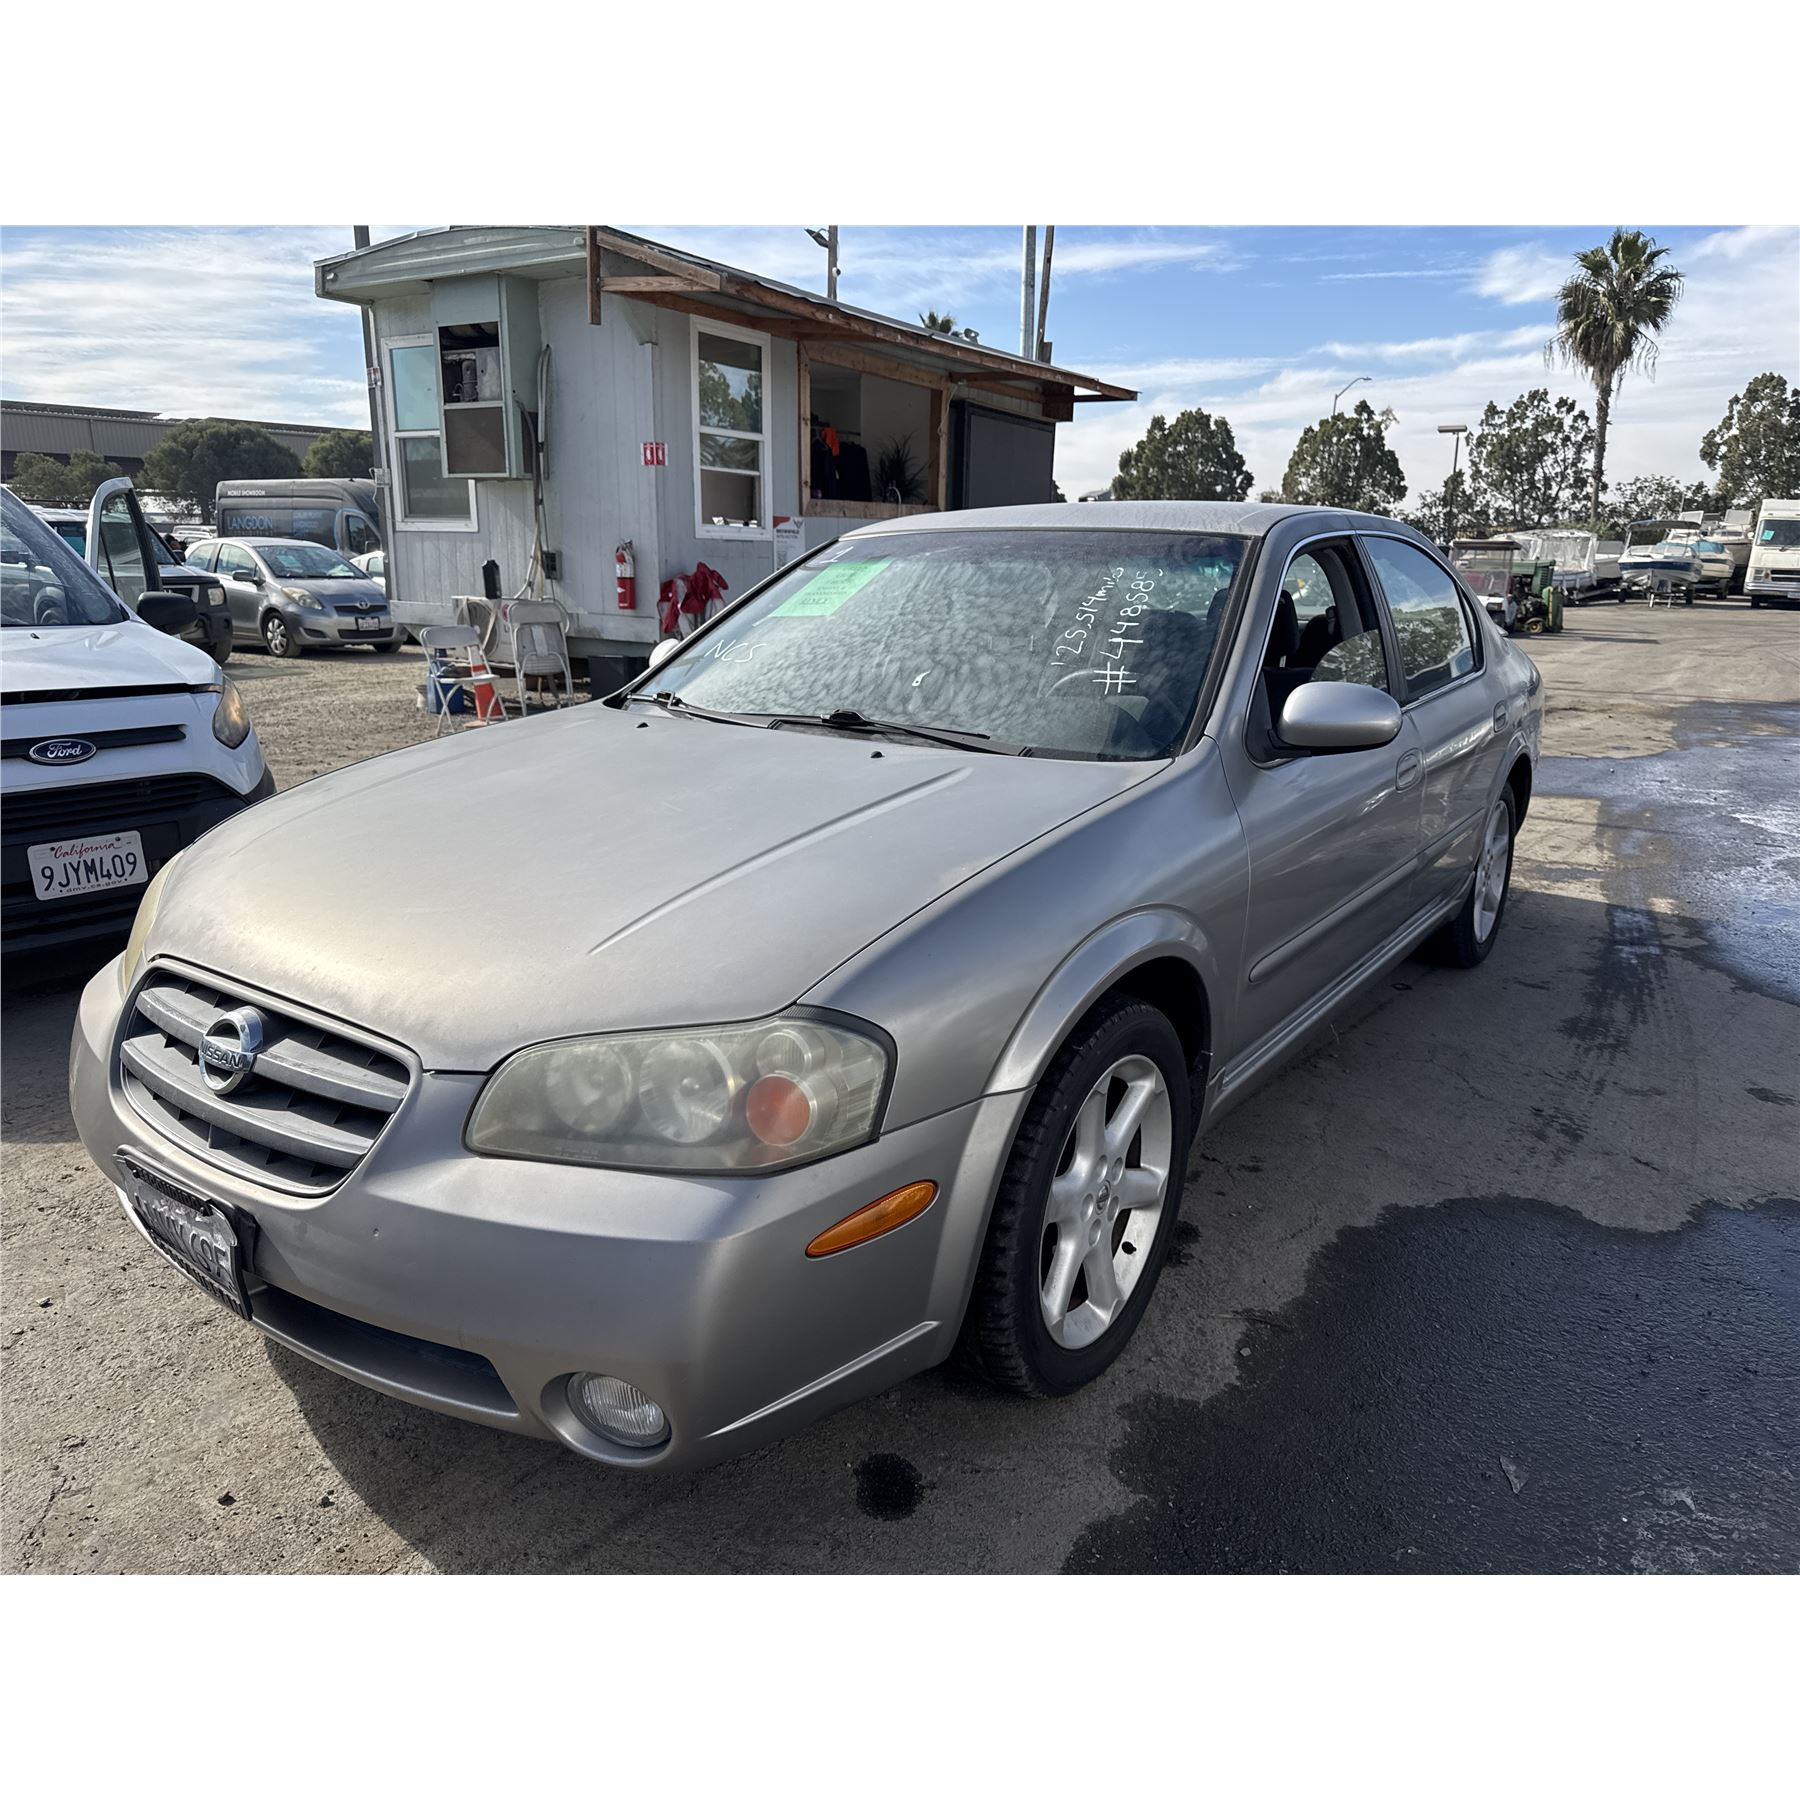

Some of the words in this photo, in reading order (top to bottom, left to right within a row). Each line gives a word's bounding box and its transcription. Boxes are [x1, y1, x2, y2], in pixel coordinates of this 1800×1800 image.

[227, 515, 273, 530] LANGDON
[46, 742, 83, 758] Ford
[53, 841, 120, 860] California
[40, 852, 137, 892] 9JYM409
[66, 879, 123, 894] dmv.ca.gov
[200, 1038, 243, 1069] NISSAN
